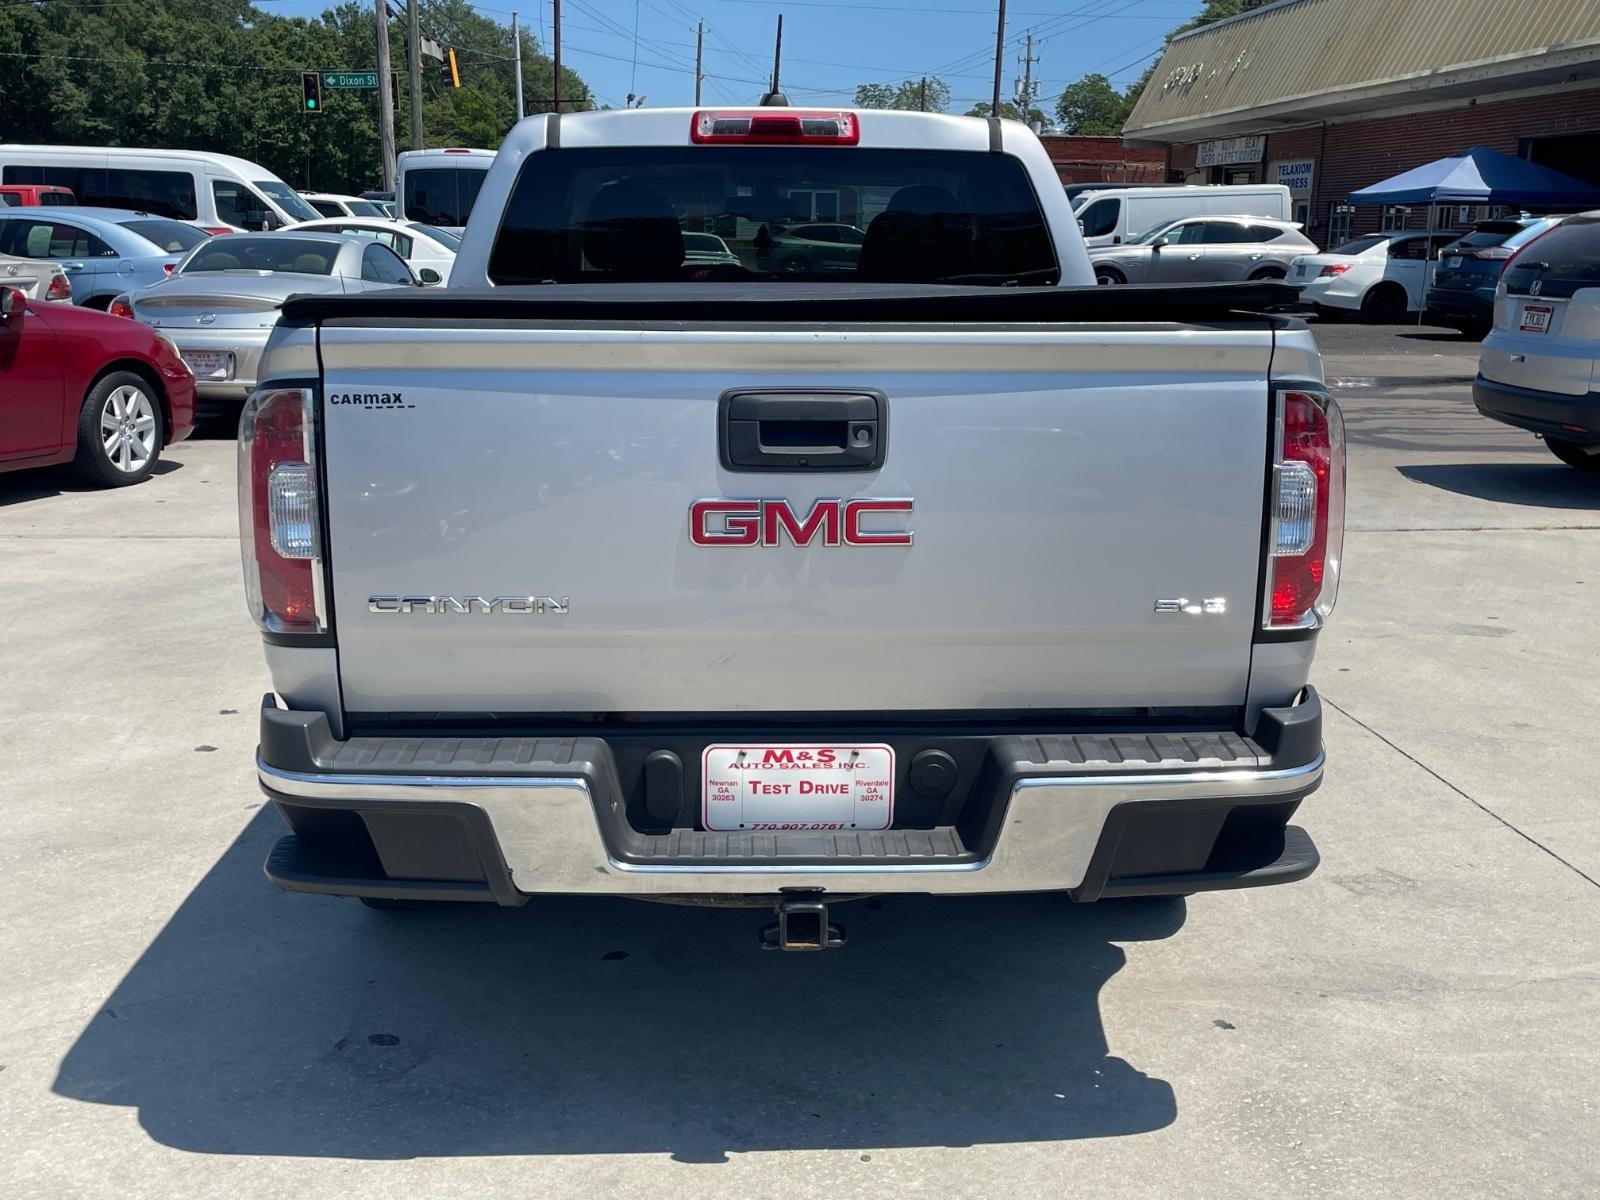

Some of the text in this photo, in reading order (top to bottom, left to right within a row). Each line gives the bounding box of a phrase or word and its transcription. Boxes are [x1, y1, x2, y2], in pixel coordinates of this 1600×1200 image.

[340, 76, 377, 85] Dixon St
[688, 497, 914, 548] GMC
[368, 595, 569, 614] CANYON
[762, 749, 837, 763] M&S
[751, 823, 845, 831] 770.907.0761
